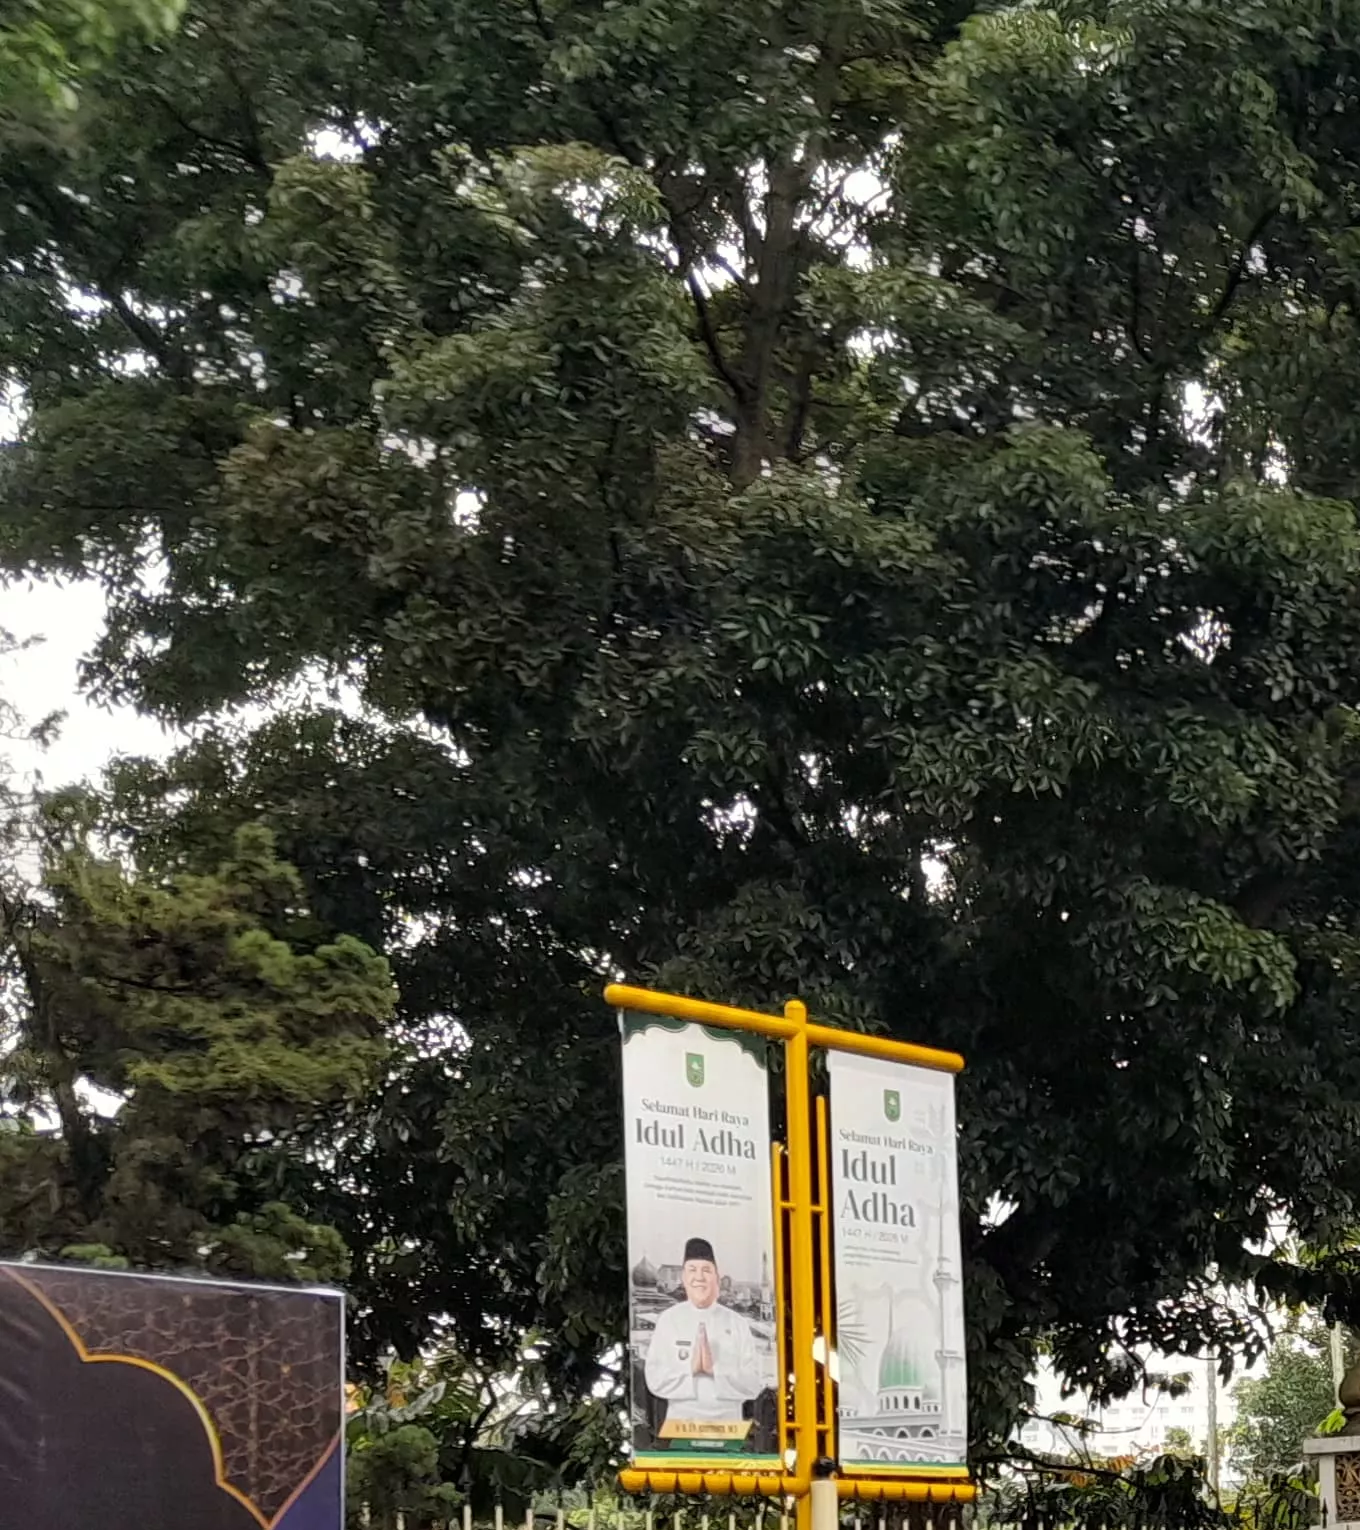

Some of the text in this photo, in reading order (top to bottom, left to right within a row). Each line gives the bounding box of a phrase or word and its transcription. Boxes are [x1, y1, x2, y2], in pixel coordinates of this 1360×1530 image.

[641, 1098, 749, 1128] Selamat Hari Raya
[636, 1118, 756, 1160] Idul Adha
[839, 1129, 933, 1156] Selamat Hari Raya
[841, 1149, 896, 1185] Idul
[840, 1189, 916, 1228] Adha
